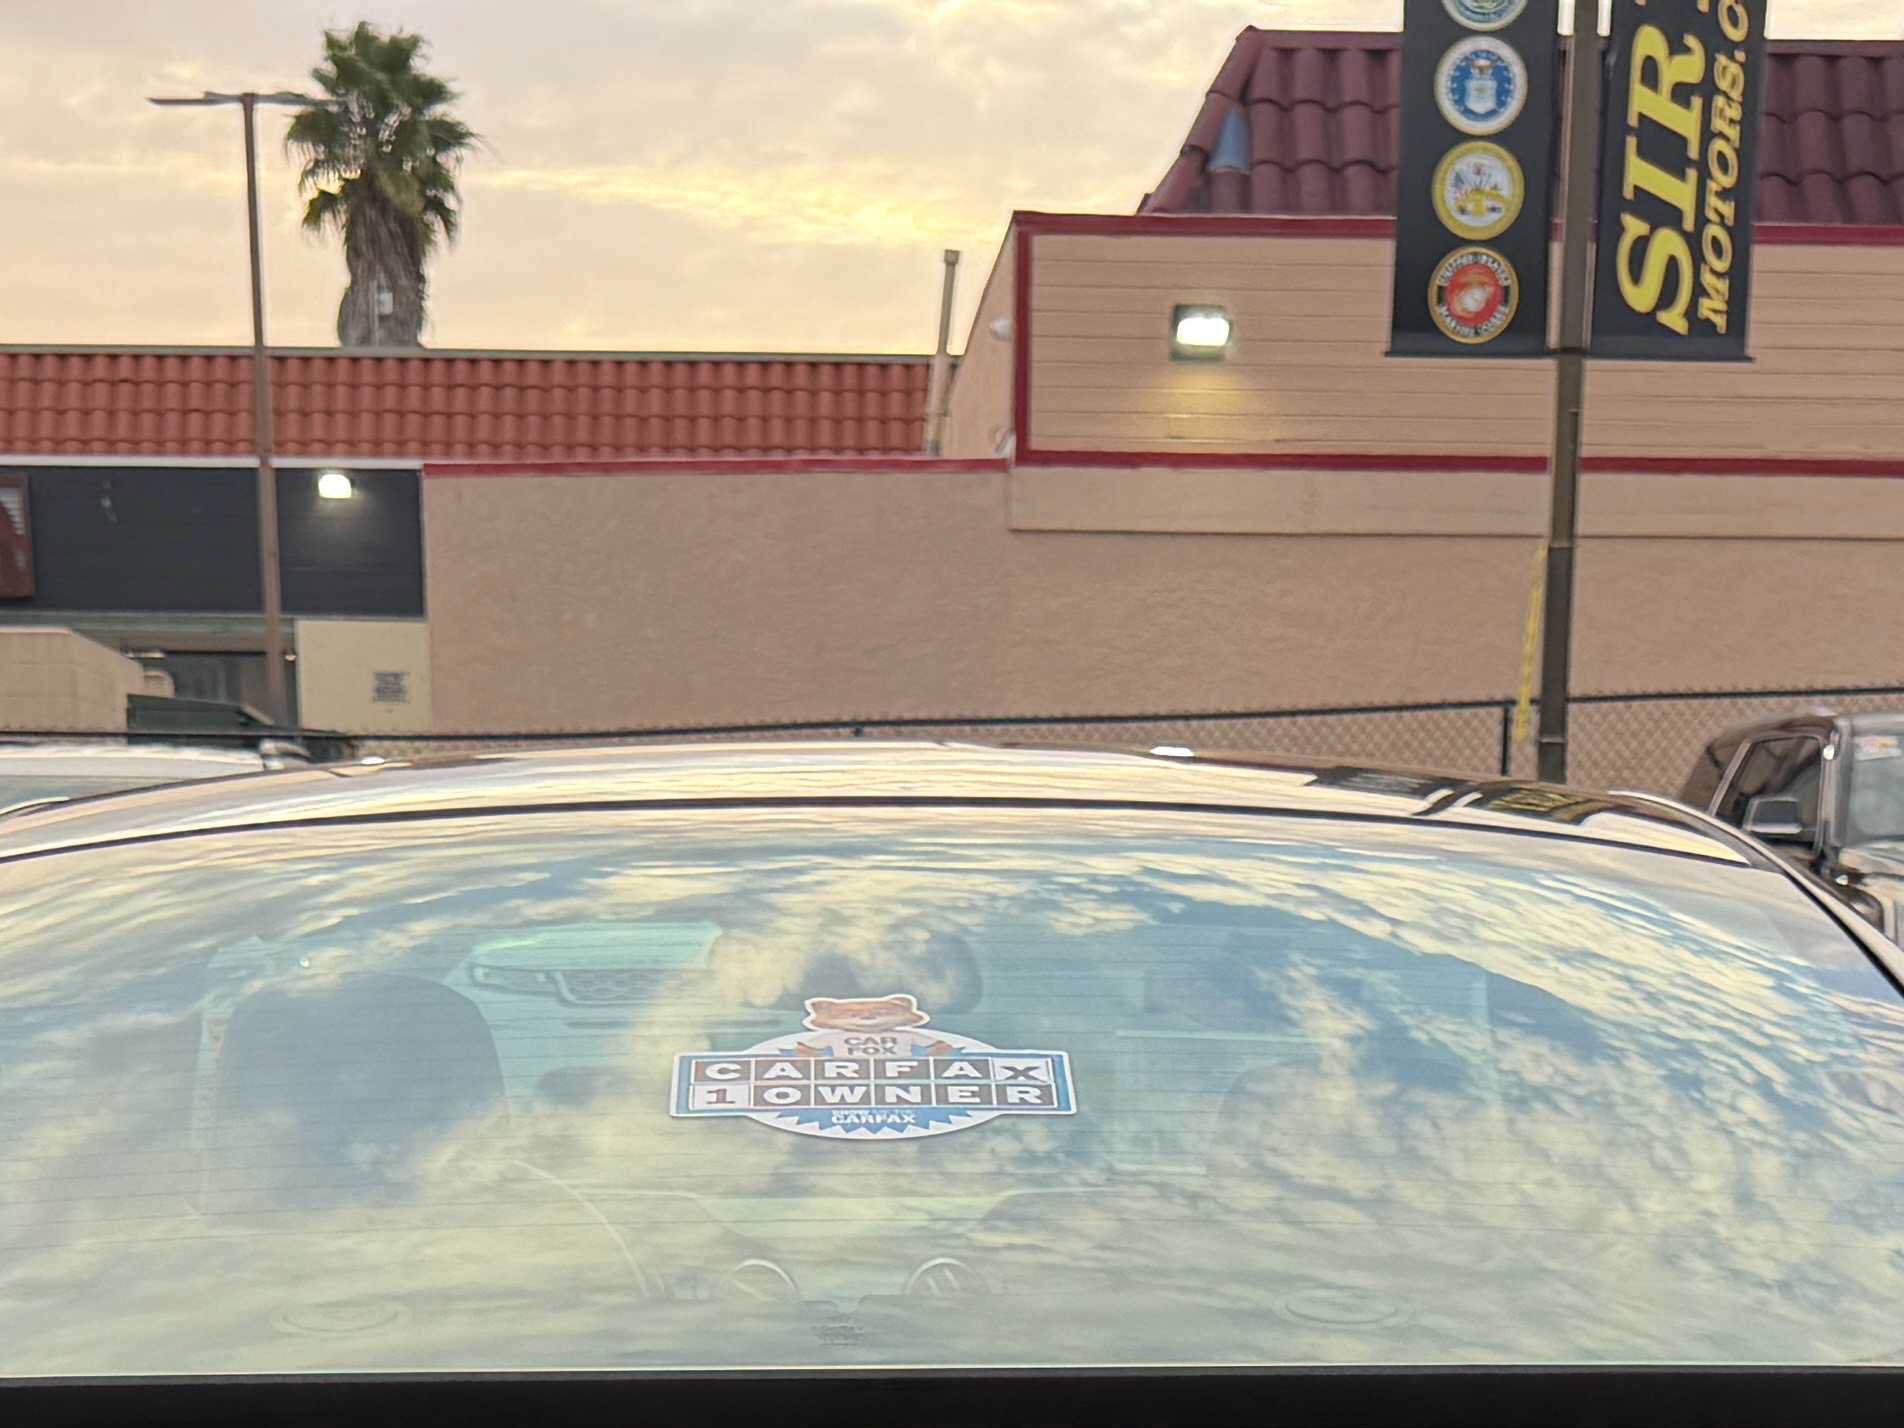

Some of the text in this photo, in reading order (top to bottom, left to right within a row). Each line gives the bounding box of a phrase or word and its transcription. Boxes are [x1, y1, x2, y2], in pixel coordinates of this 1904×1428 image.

[1616, 0, 1709, 336] SIR
[843, 1036, 898, 1046] CAR
[846, 1046, 897, 1055] FOX
[705, 1060, 1049, 1083] CARFAX
[706, 1085, 1044, 1105] 1 OWNER
